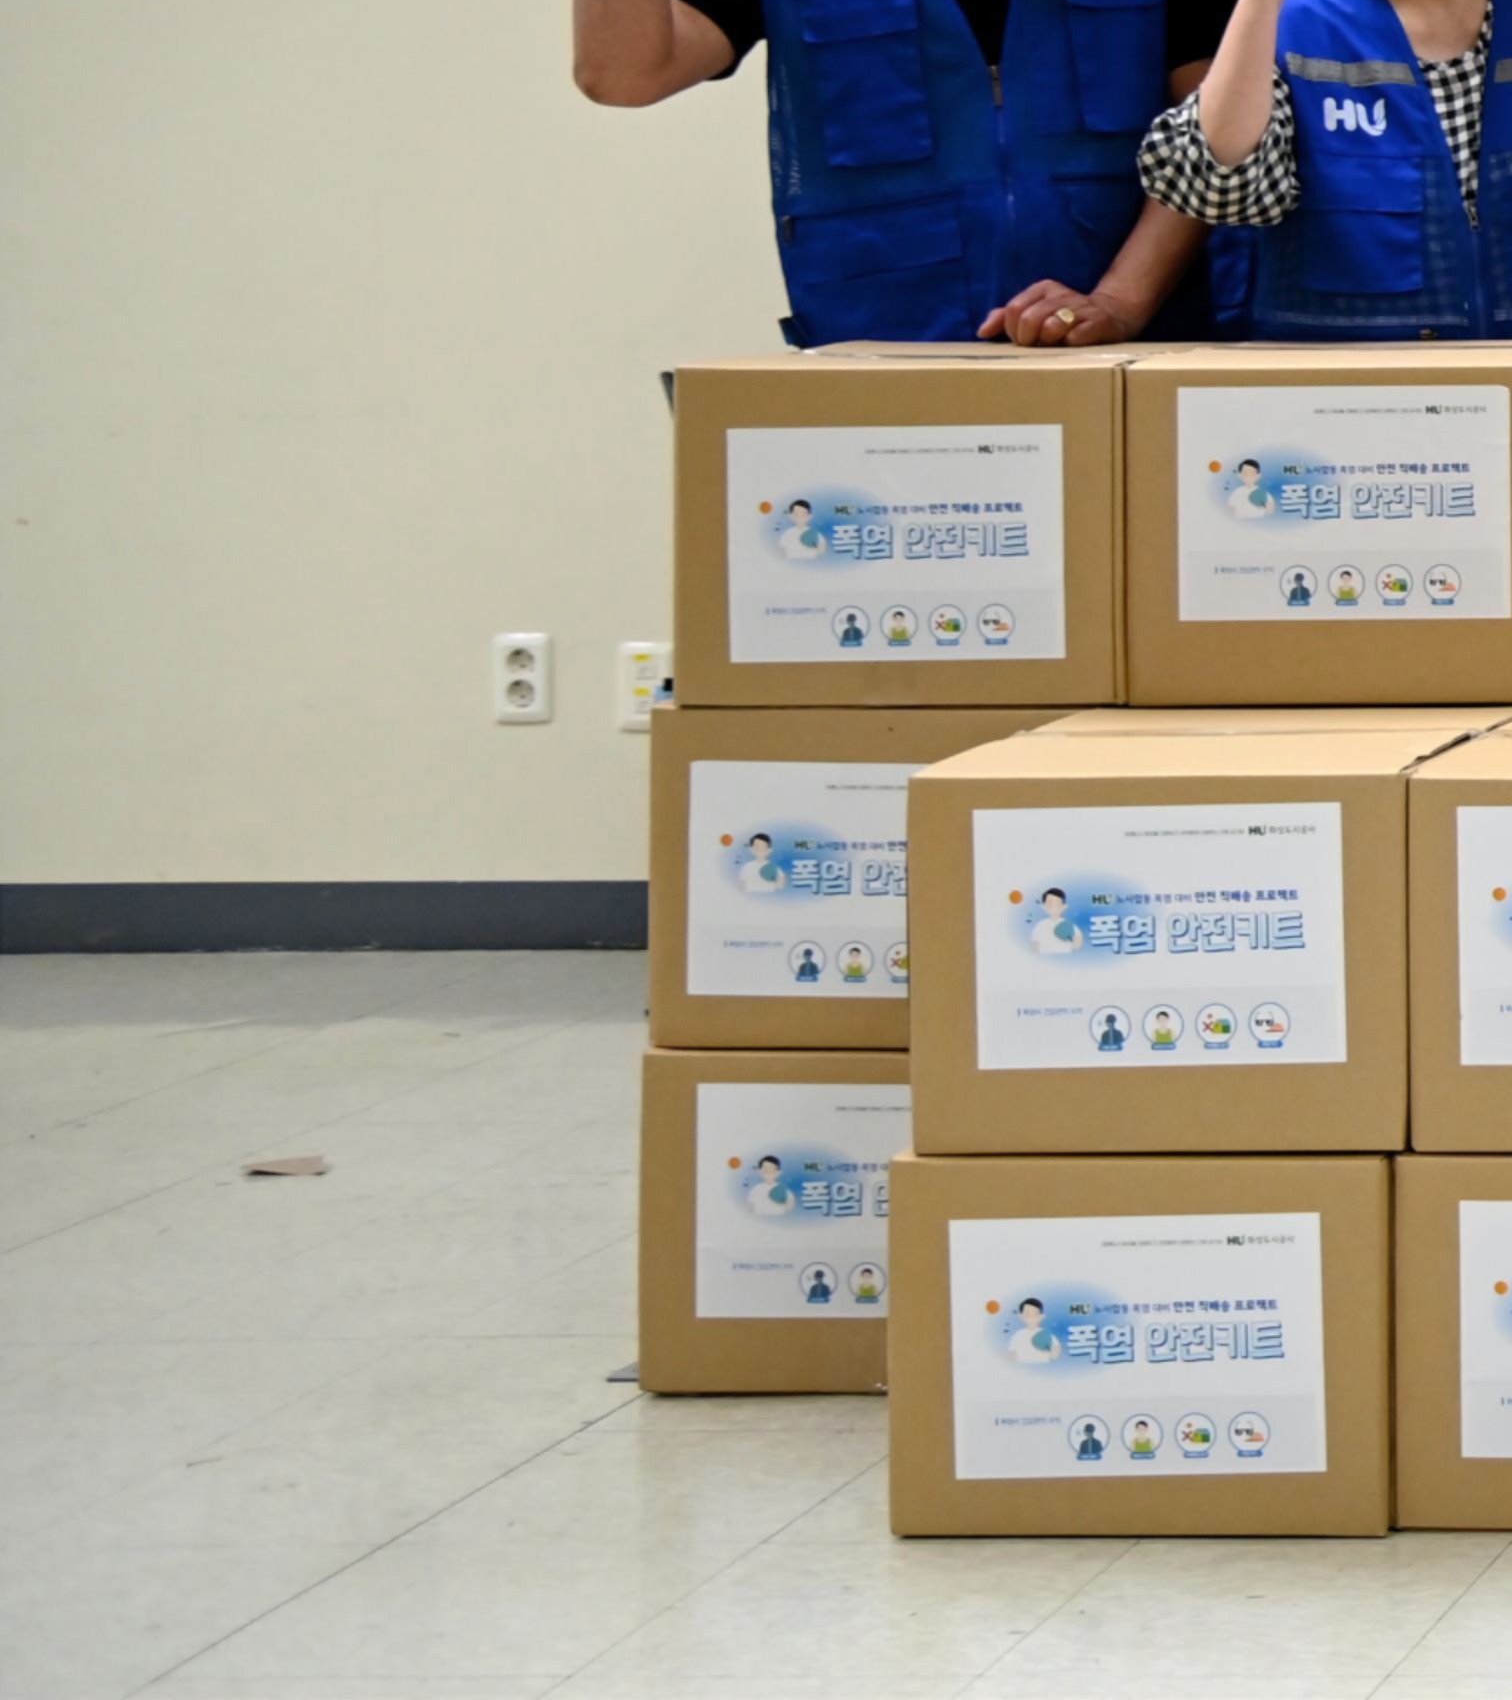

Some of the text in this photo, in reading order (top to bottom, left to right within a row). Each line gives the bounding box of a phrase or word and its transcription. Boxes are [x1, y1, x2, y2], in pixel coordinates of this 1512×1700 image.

[1323, 97, 1387, 136] HU
[1278, 479, 1476, 521] 폭염 안전키트
[830, 518, 1029, 561] 폭염 안전키트
[790, 858, 851, 896] 폭염
[1087, 907, 1305, 956] 폭염 안전키트
[799, 1180, 862, 1218] 폭염
[1065, 1317, 1285, 1366] 폭염 안전키트
